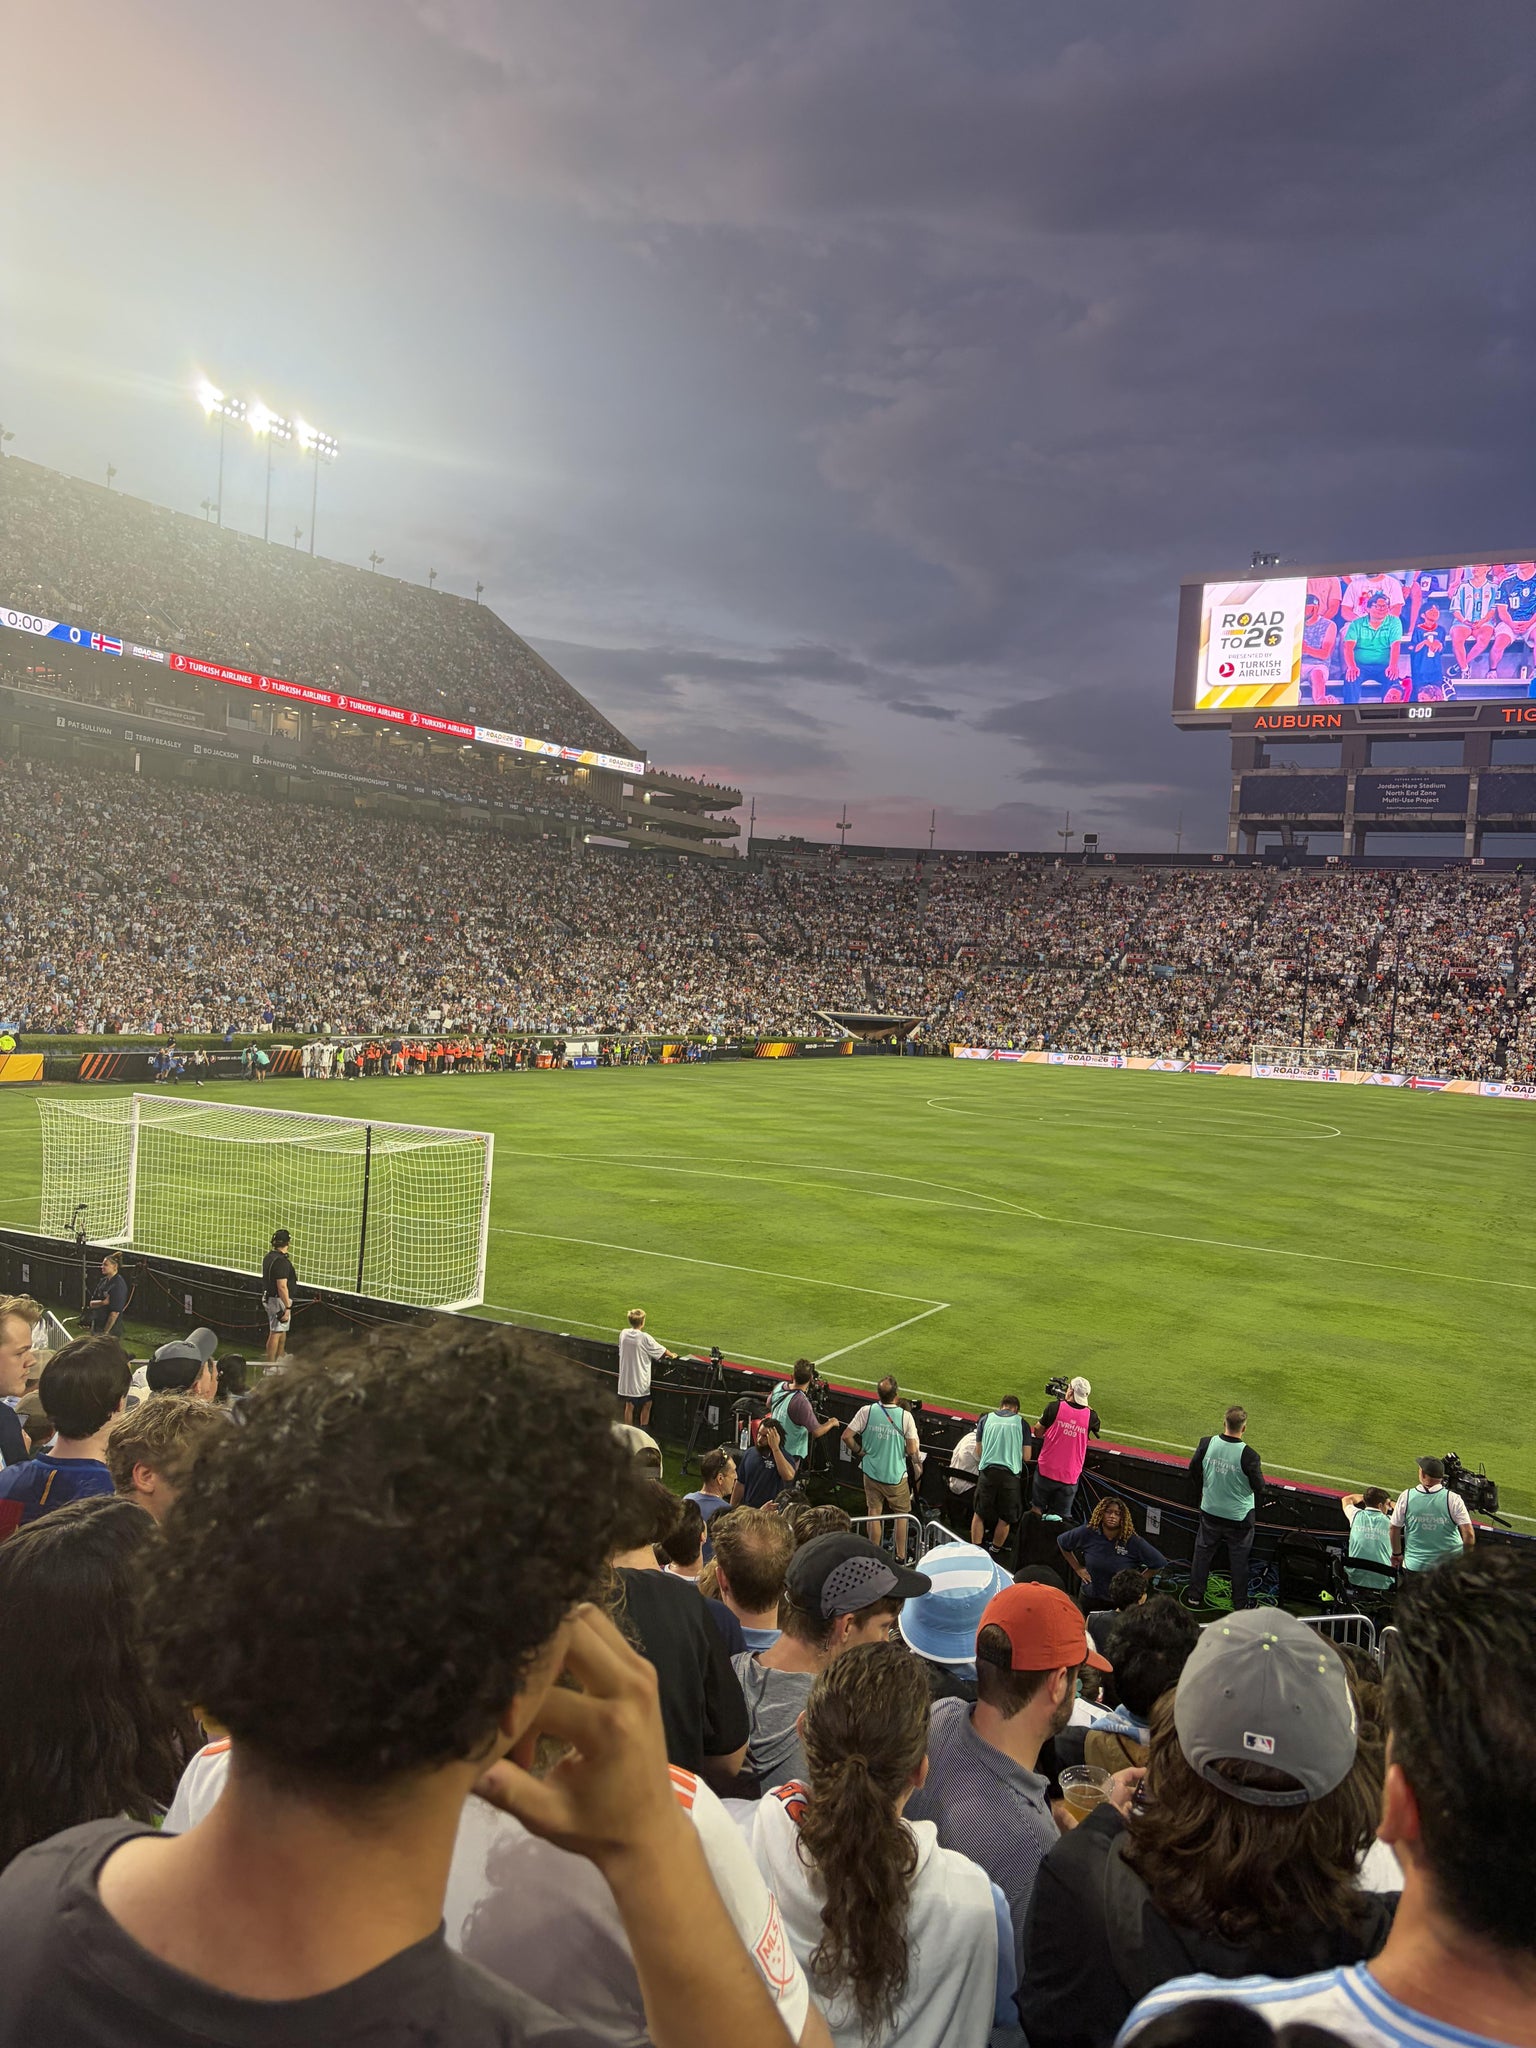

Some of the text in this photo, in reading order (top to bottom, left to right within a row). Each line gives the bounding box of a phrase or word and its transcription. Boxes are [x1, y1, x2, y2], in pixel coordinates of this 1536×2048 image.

[8, 612, 43, 632] 0:00
[1222, 610, 1285, 628] ROAD
[69, 627, 82, 643] 0
[1221, 626, 1284, 649] TO 26
[188, 661, 252, 684] TURKISH AIRLINES
[1240, 660, 1282, 669] TURKISH
[1239, 669, 1281, 677] AIRLINES
[271, 682, 331, 703] TURKISH AIRLINES
[349, 700, 404, 720] TURKISH AIRLINES
[1409, 707, 1432, 718] 0:00
[67, 720, 113, 735] PAT SULLIVAN
[421, 717, 472, 736] TURKISH AIRLINES
[1254, 714, 1342, 729] AUBURN
[135, 733, 155, 743] TERRY
[155, 738, 181, 749] BEASLEY
[213, 749, 239, 759] JACKSON
[259, 758, 297, 771] CAM NEWTON
[312, 769, 390, 787] CONFERENCE CHAMPIONSHIPS
[1068, 1054, 1091, 1062] ROAD
[1273, 1067, 1300, 1075] ROAD
[1504, 1085, 1535, 1094] ROAD
[763, 1920, 778, 1959] MLS
